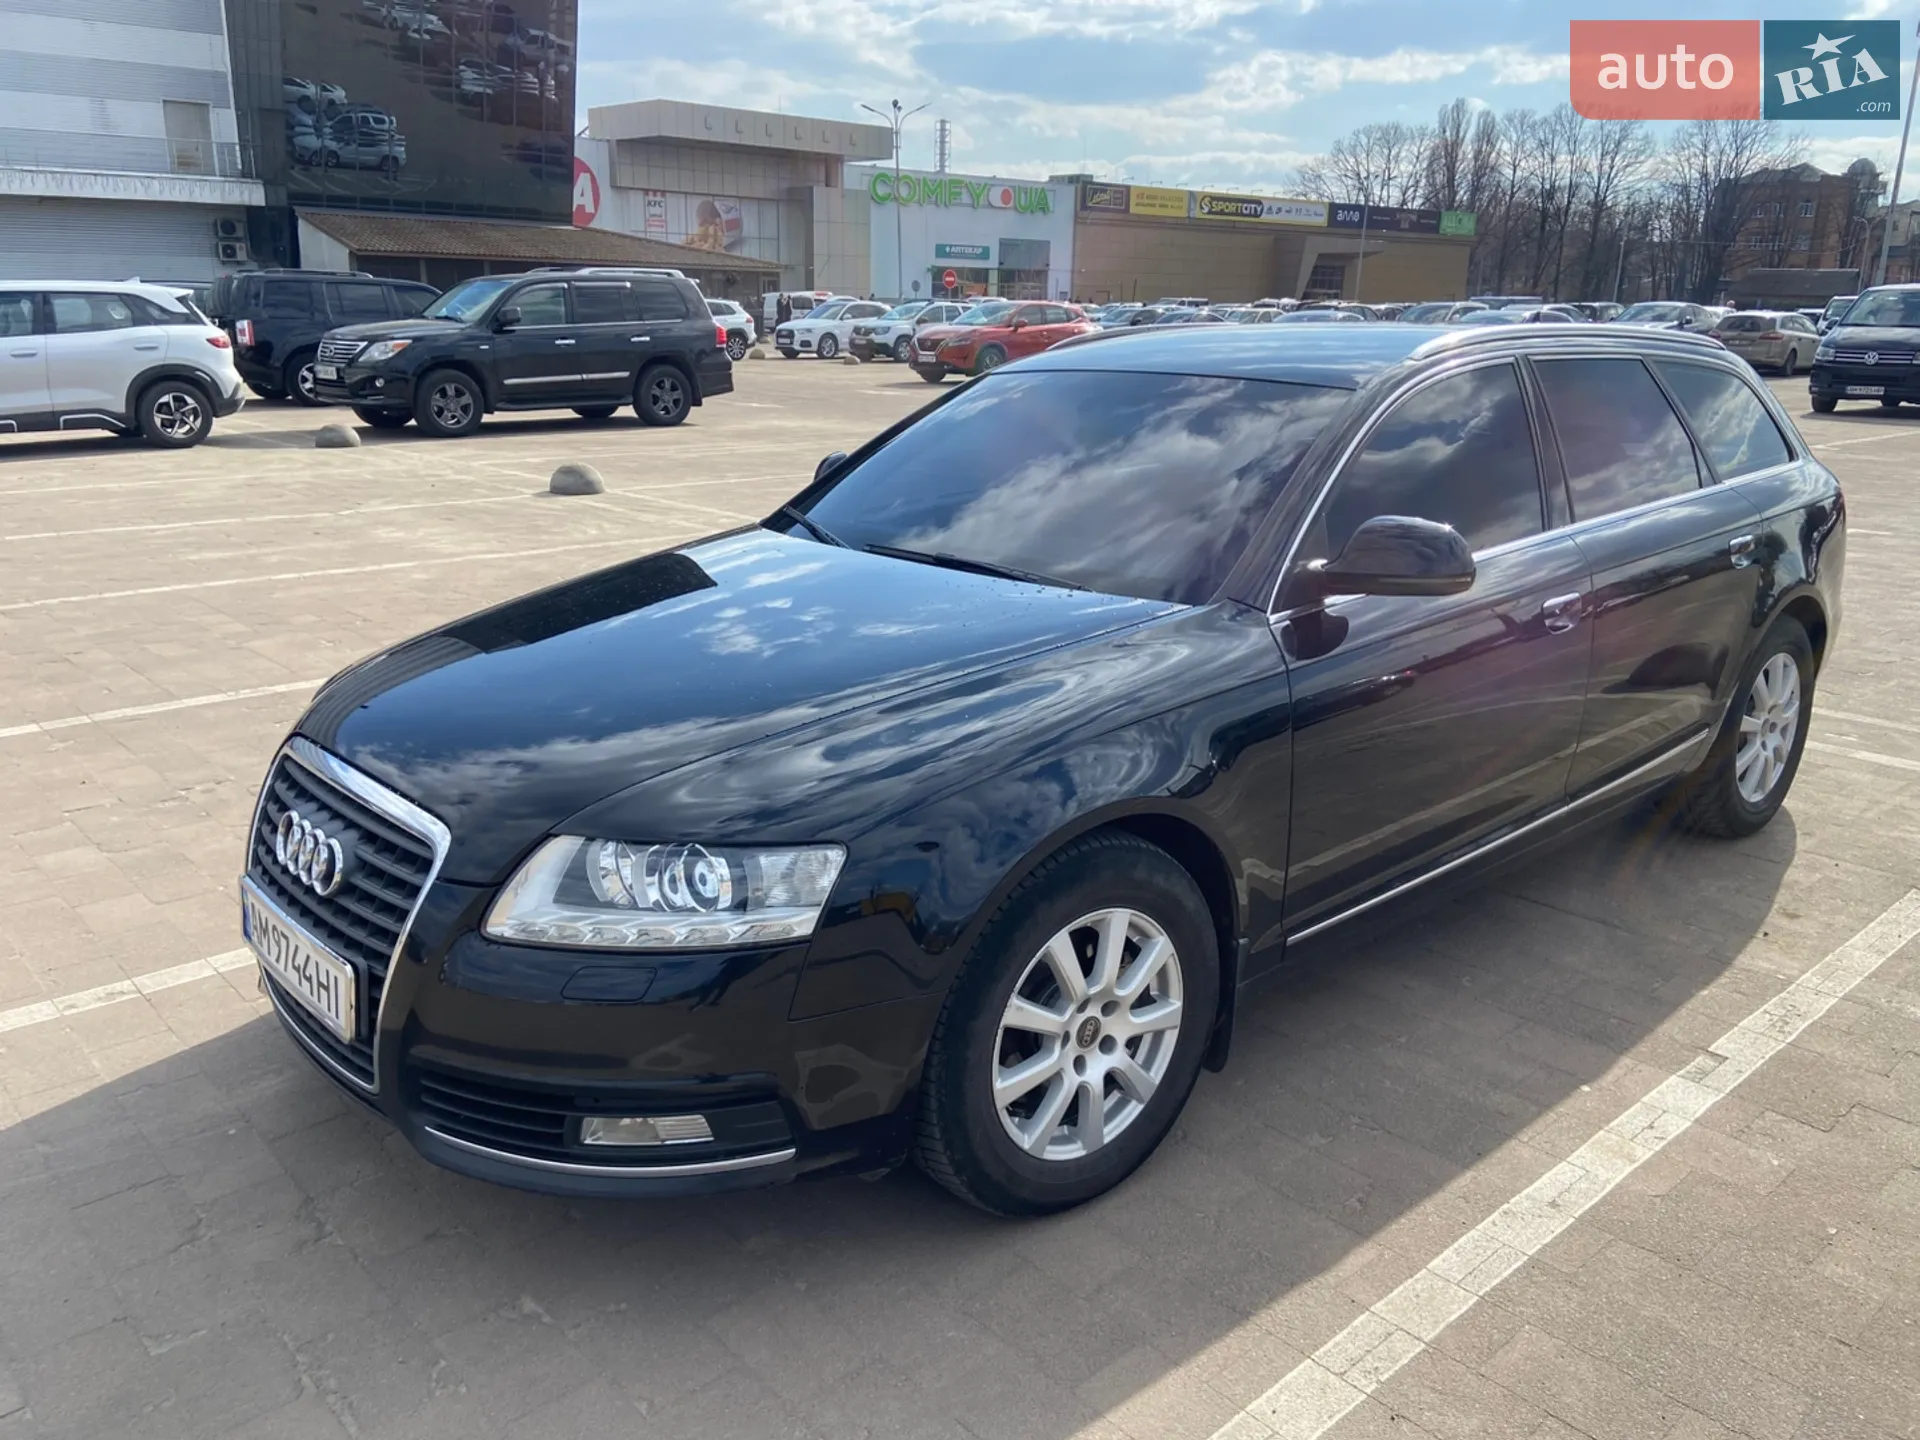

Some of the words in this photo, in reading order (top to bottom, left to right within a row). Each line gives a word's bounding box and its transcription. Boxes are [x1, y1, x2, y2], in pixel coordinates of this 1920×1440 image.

[573, 172, 595, 213] A
[646, 200, 664, 209] KFC
[870, 171, 989, 209] COMFY
[1015, 184, 1051, 214] UA
[251, 901, 340, 1021] AM9744HI
